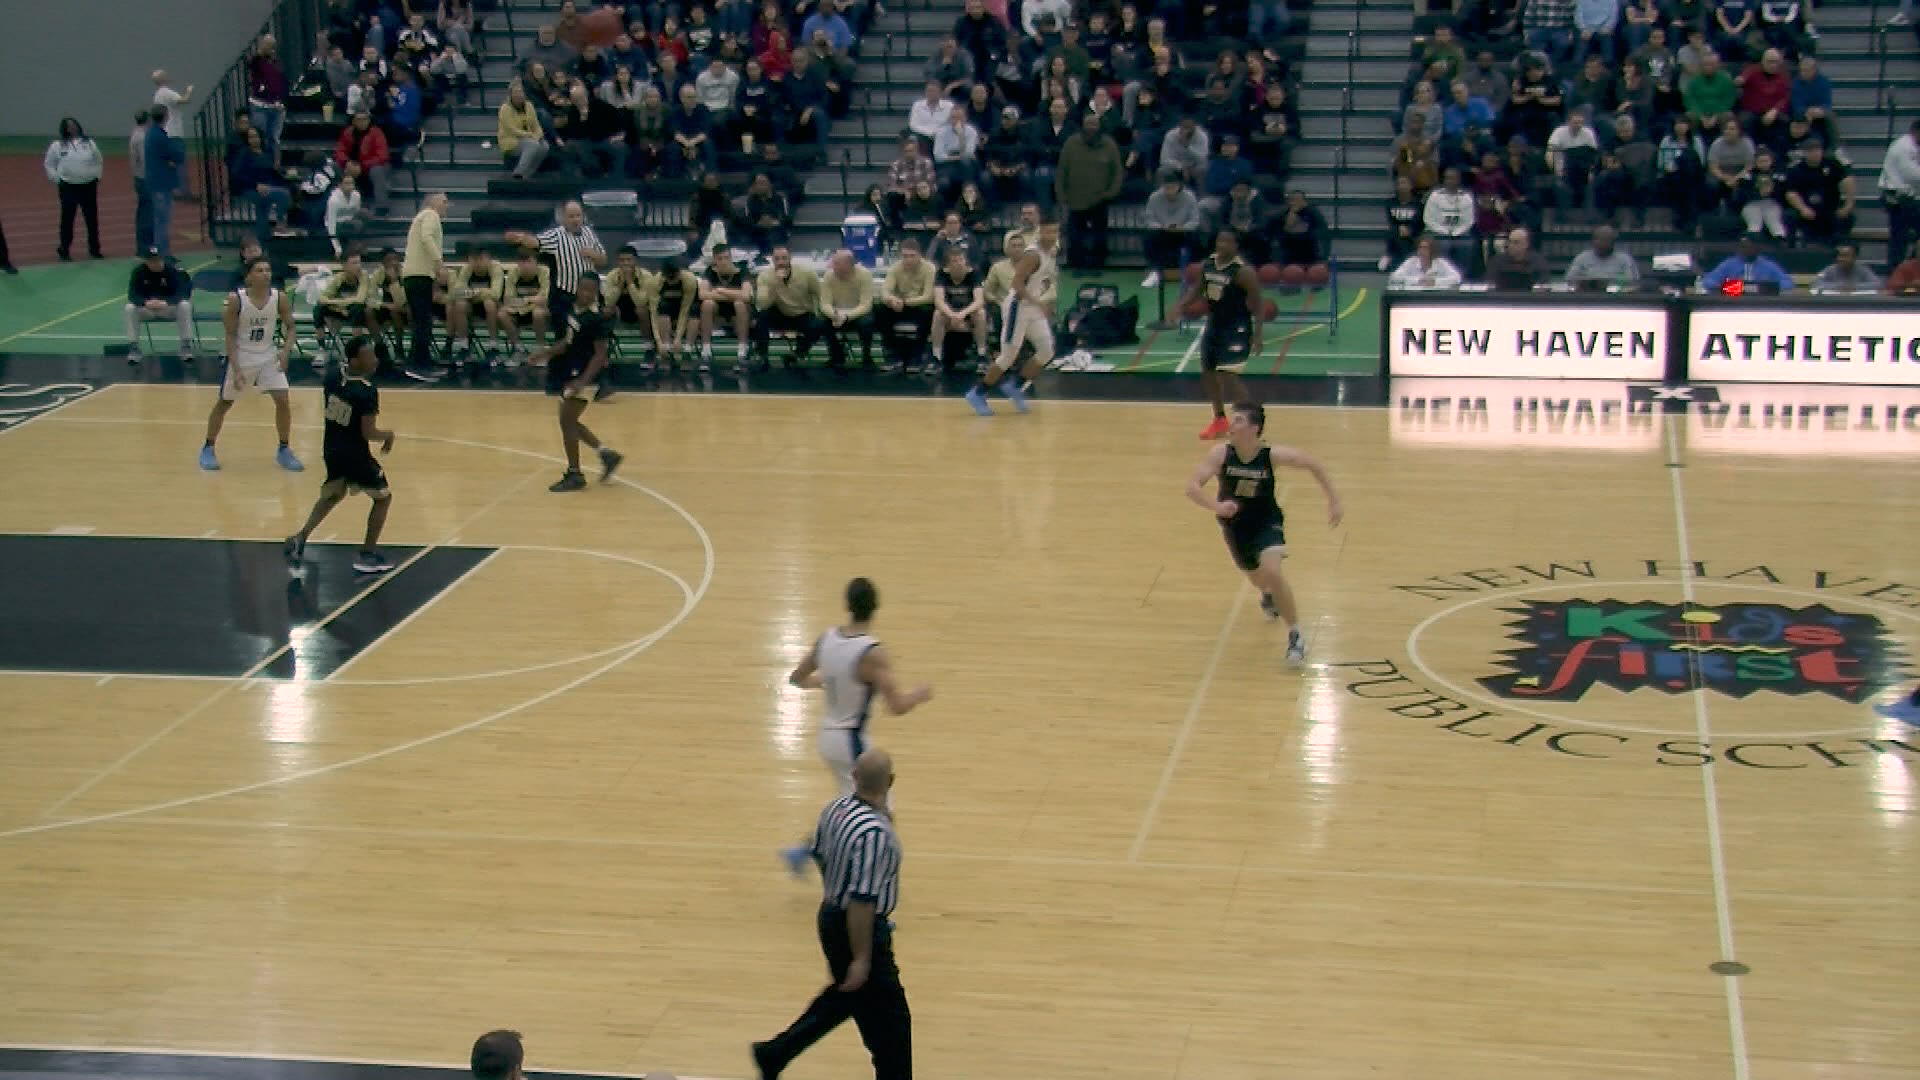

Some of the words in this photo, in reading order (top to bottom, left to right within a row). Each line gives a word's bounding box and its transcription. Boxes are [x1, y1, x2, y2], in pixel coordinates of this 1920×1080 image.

[1402, 328, 1491, 356] NEW
[1513, 329, 1655, 359] HAVEN
[1392, 559, 1596, 600] NEW
[1328, 659, 1632, 759] PUBLIC
